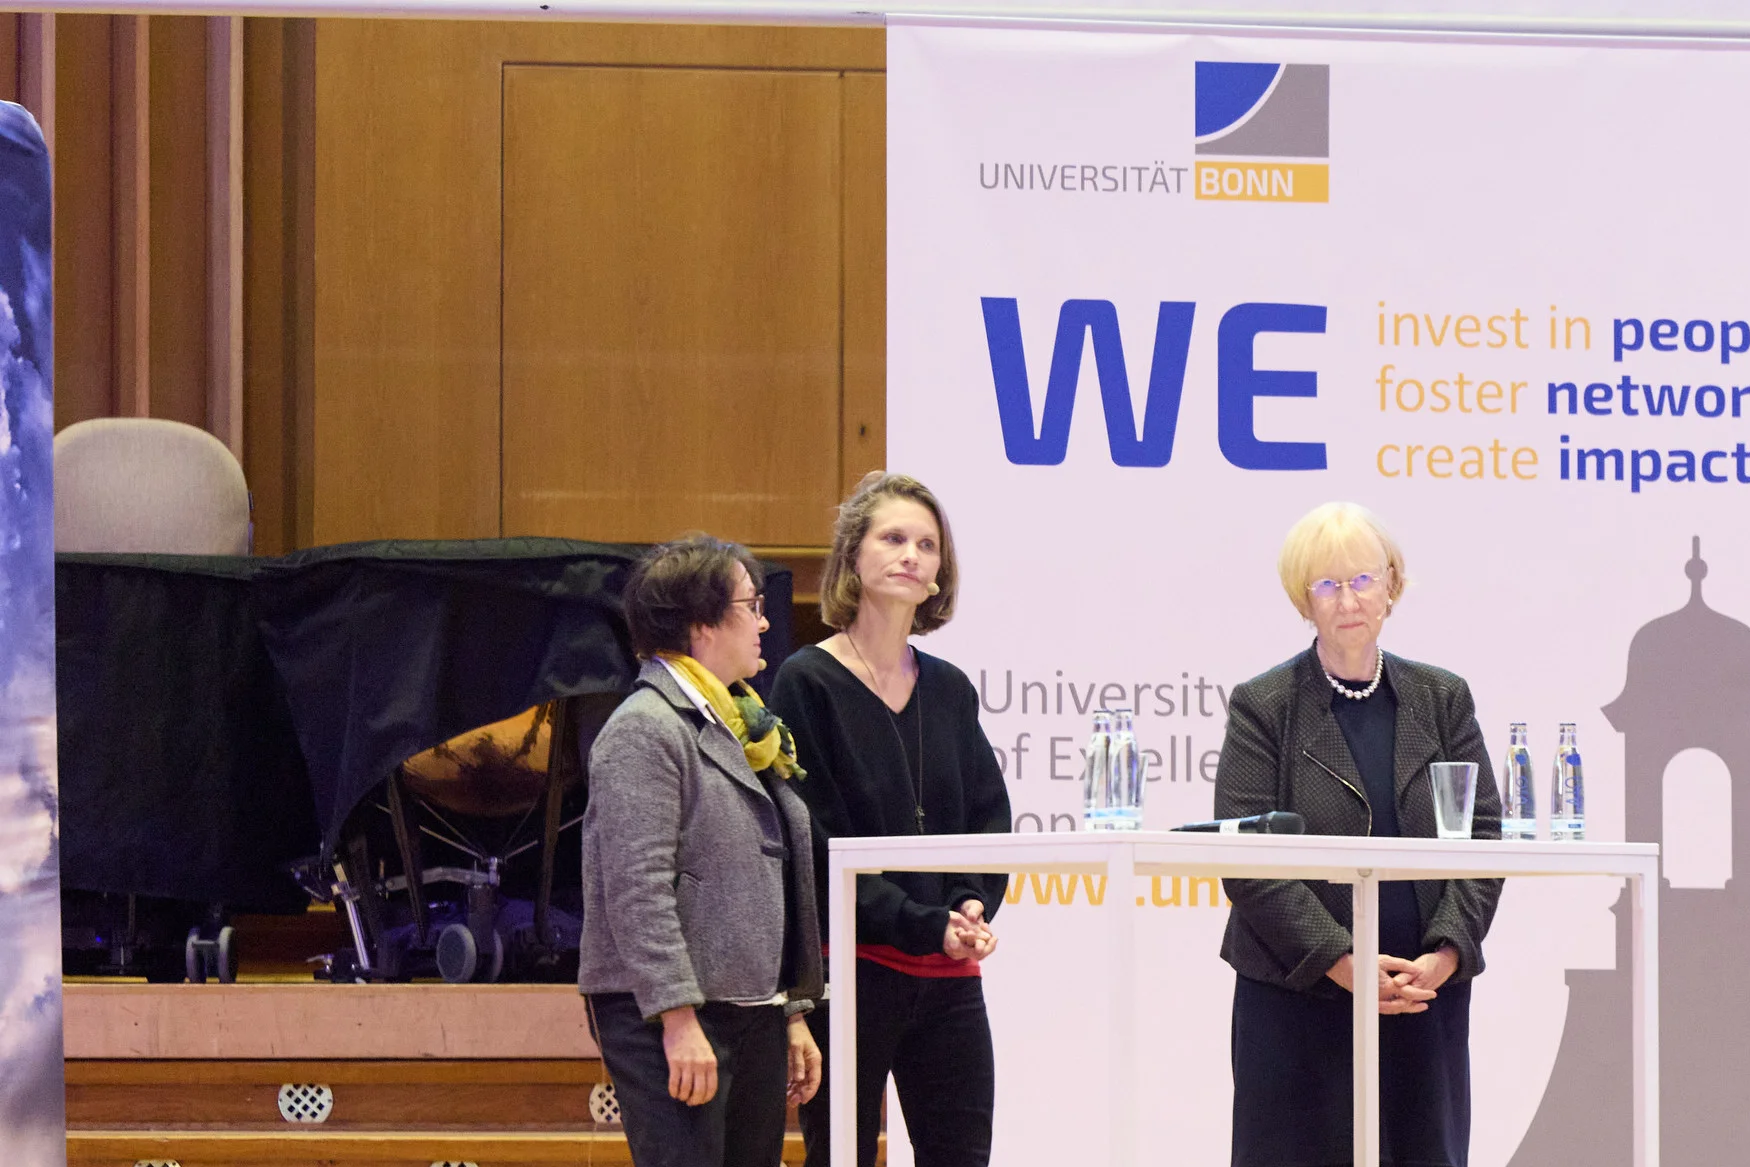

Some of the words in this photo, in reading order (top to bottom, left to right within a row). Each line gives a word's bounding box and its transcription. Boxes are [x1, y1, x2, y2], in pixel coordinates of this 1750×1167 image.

[980, 161, 1188, 194] UNIVERSITÄT
[1200, 167, 1294, 197] BONN
[1377, 300, 1529, 350] invest
[1549, 304, 1591, 351] in
[980, 297, 1328, 471] WE
[1376, 364, 1529, 415] foster
[1376, 438, 1539, 481] create
